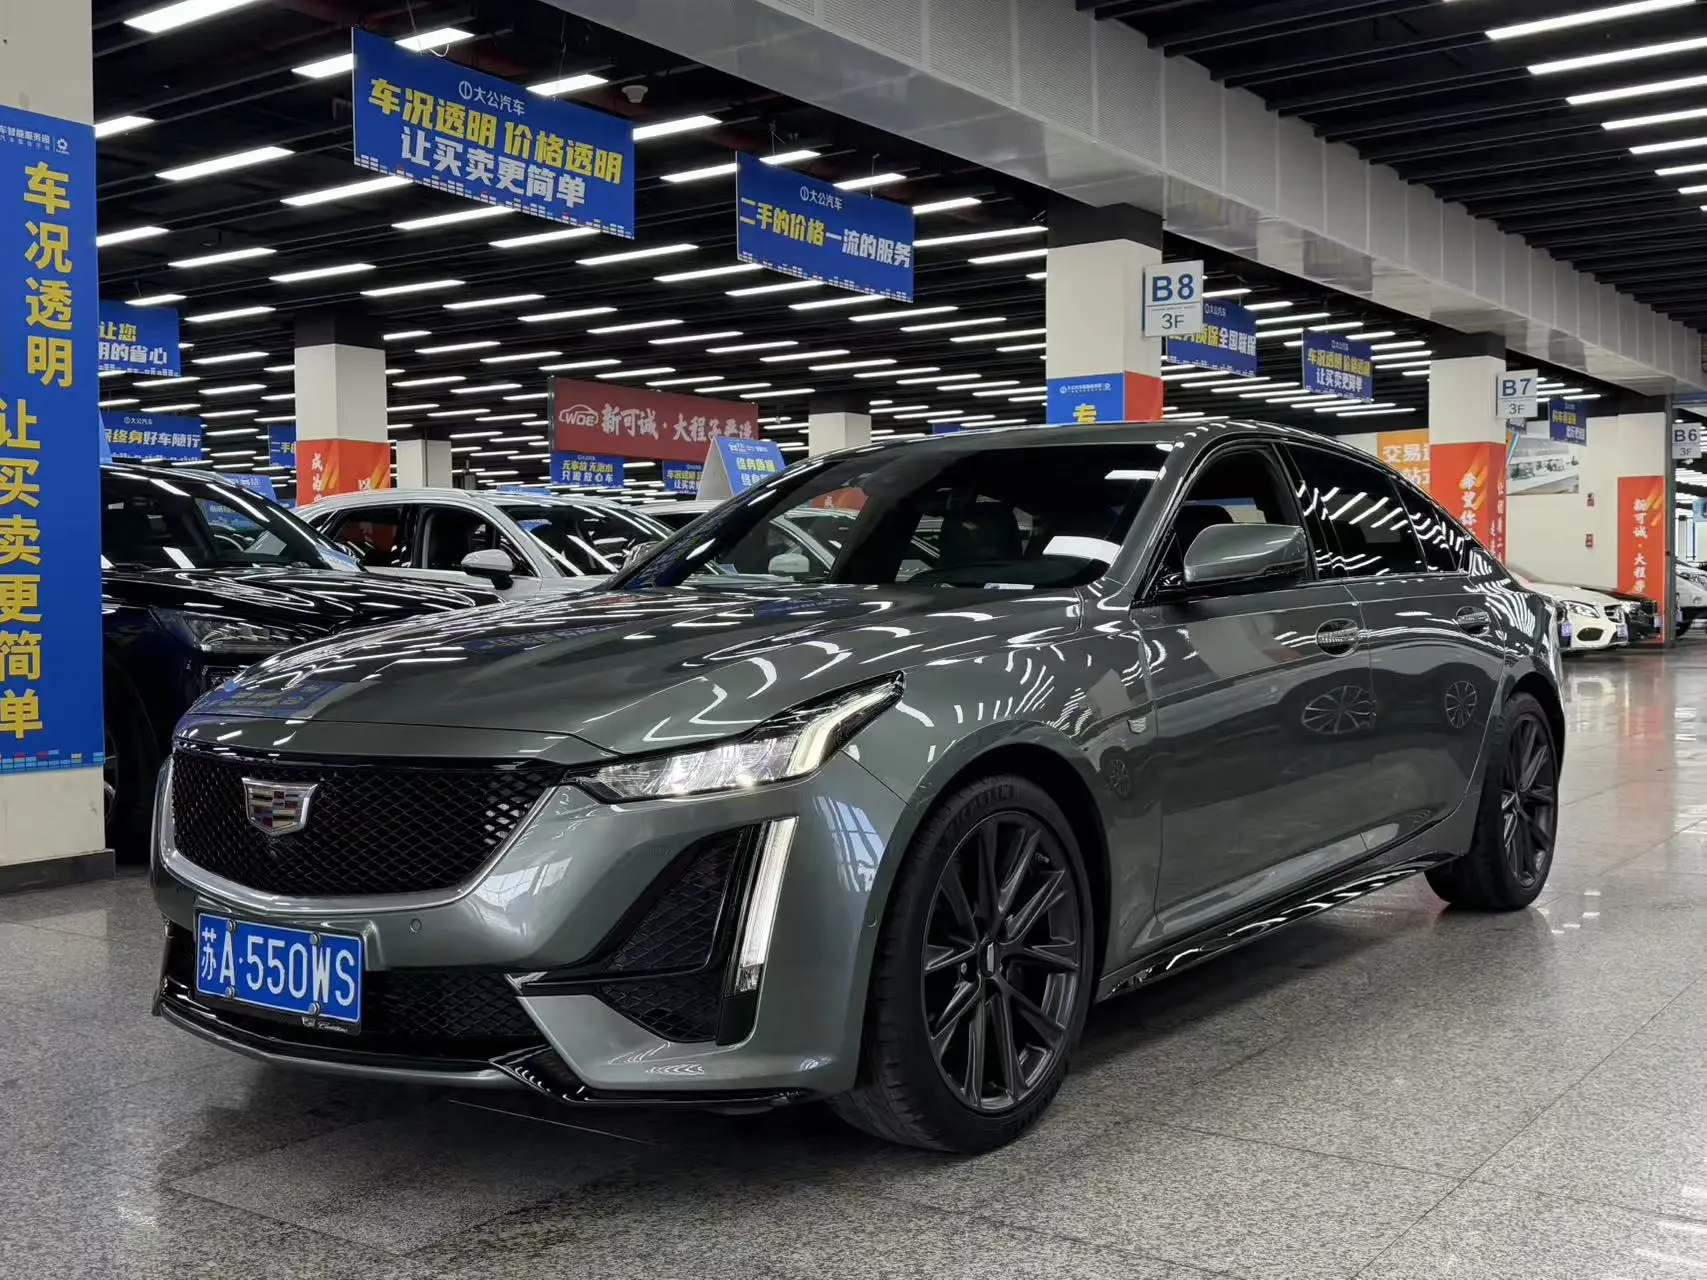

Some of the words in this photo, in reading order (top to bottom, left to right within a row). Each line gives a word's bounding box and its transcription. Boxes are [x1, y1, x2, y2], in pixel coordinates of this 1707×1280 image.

[473, 86, 525, 116] 大公汽车
[368, 78, 498, 149] 车况透明
[504, 119, 623, 185] 价格透明
[401, 127, 585, 209] 让买卖更简单
[809, 189, 843, 211] 大公汽车
[24, 161, 72, 388] 车况透明
[1152, 273, 1194, 302] B8
[1162, 313, 1184, 330] 3F
[1502, 378, 1531, 397] B7
[1509, 403, 1525, 415] 3F
[1674, 428, 1697, 442] B6
[1680, 447, 1692, 456] 3F
[0, 398, 43, 739] 让买卖更简单
[201, 927, 356, 1007] 苏A·550WS
